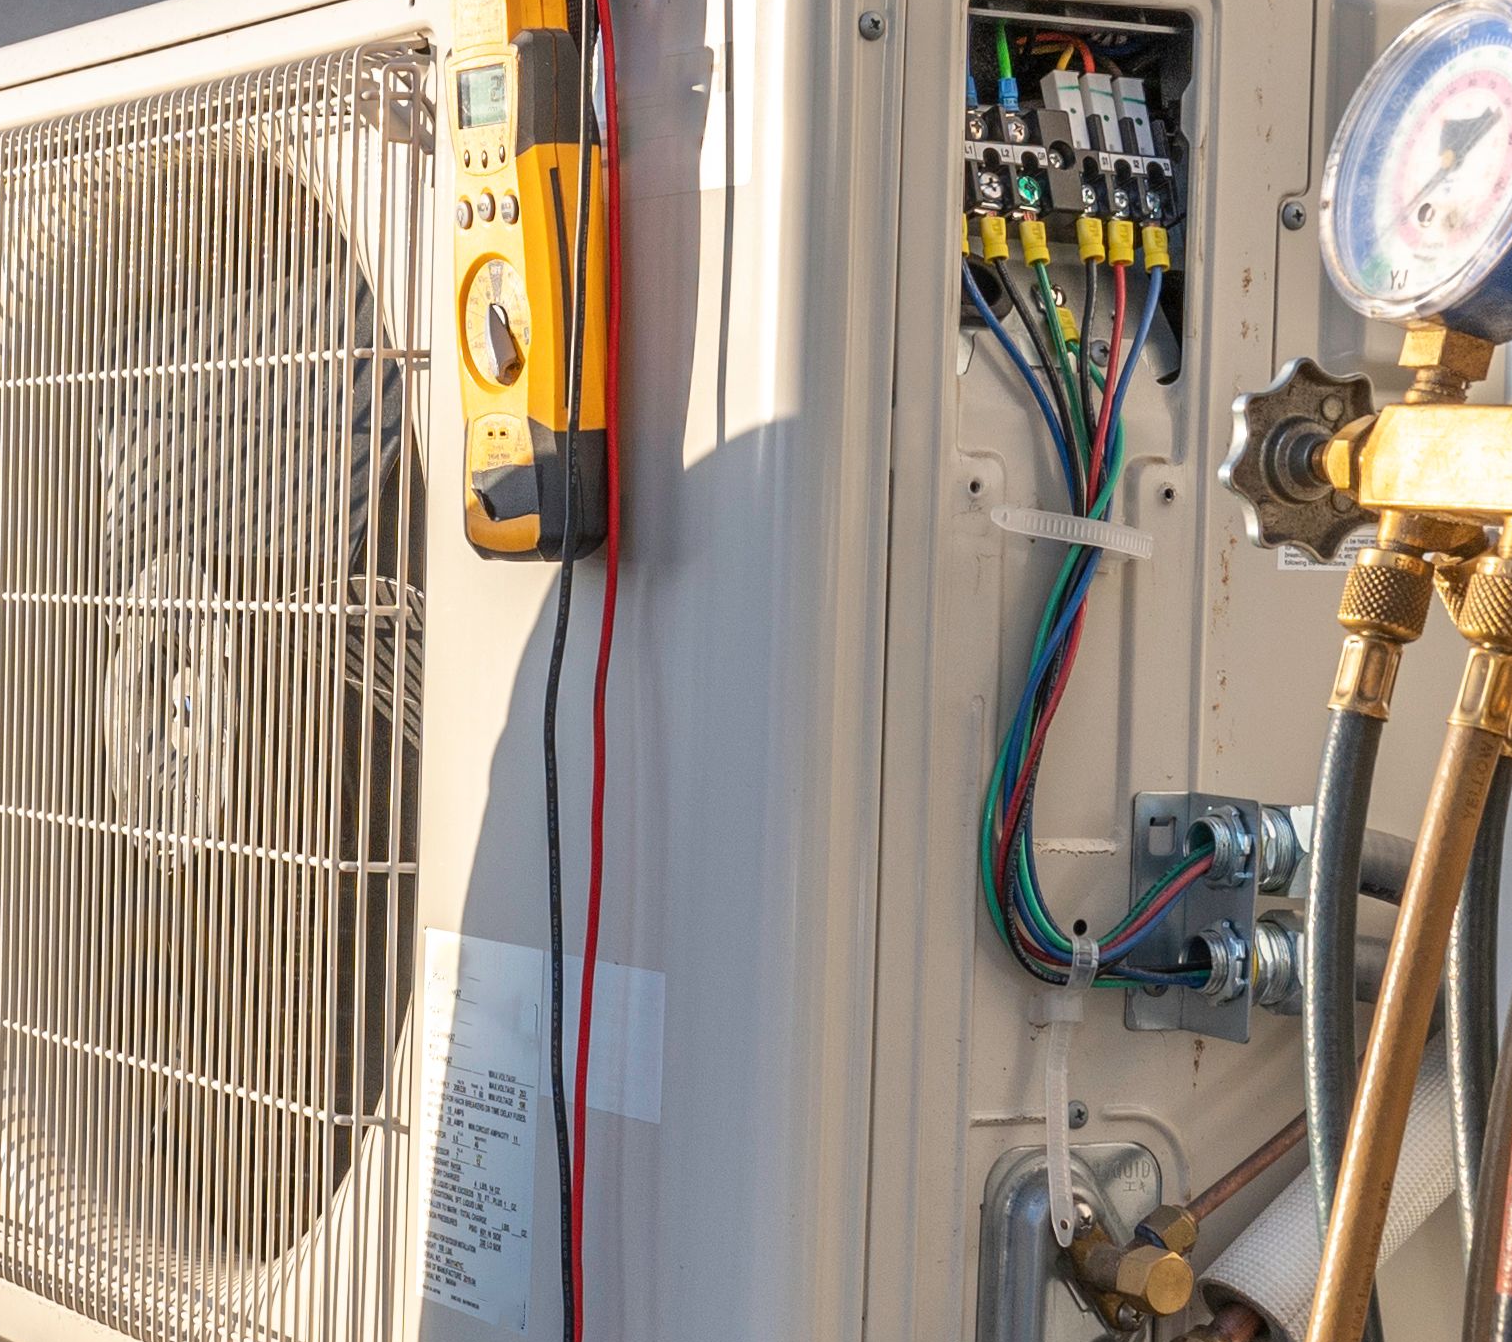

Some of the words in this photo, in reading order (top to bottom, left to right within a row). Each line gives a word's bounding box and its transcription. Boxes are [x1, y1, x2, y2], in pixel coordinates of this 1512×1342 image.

[964, 143, 973, 155] L1
[1000, 148, 1010, 158] L2
[1284, 559, 1307, 567] following
